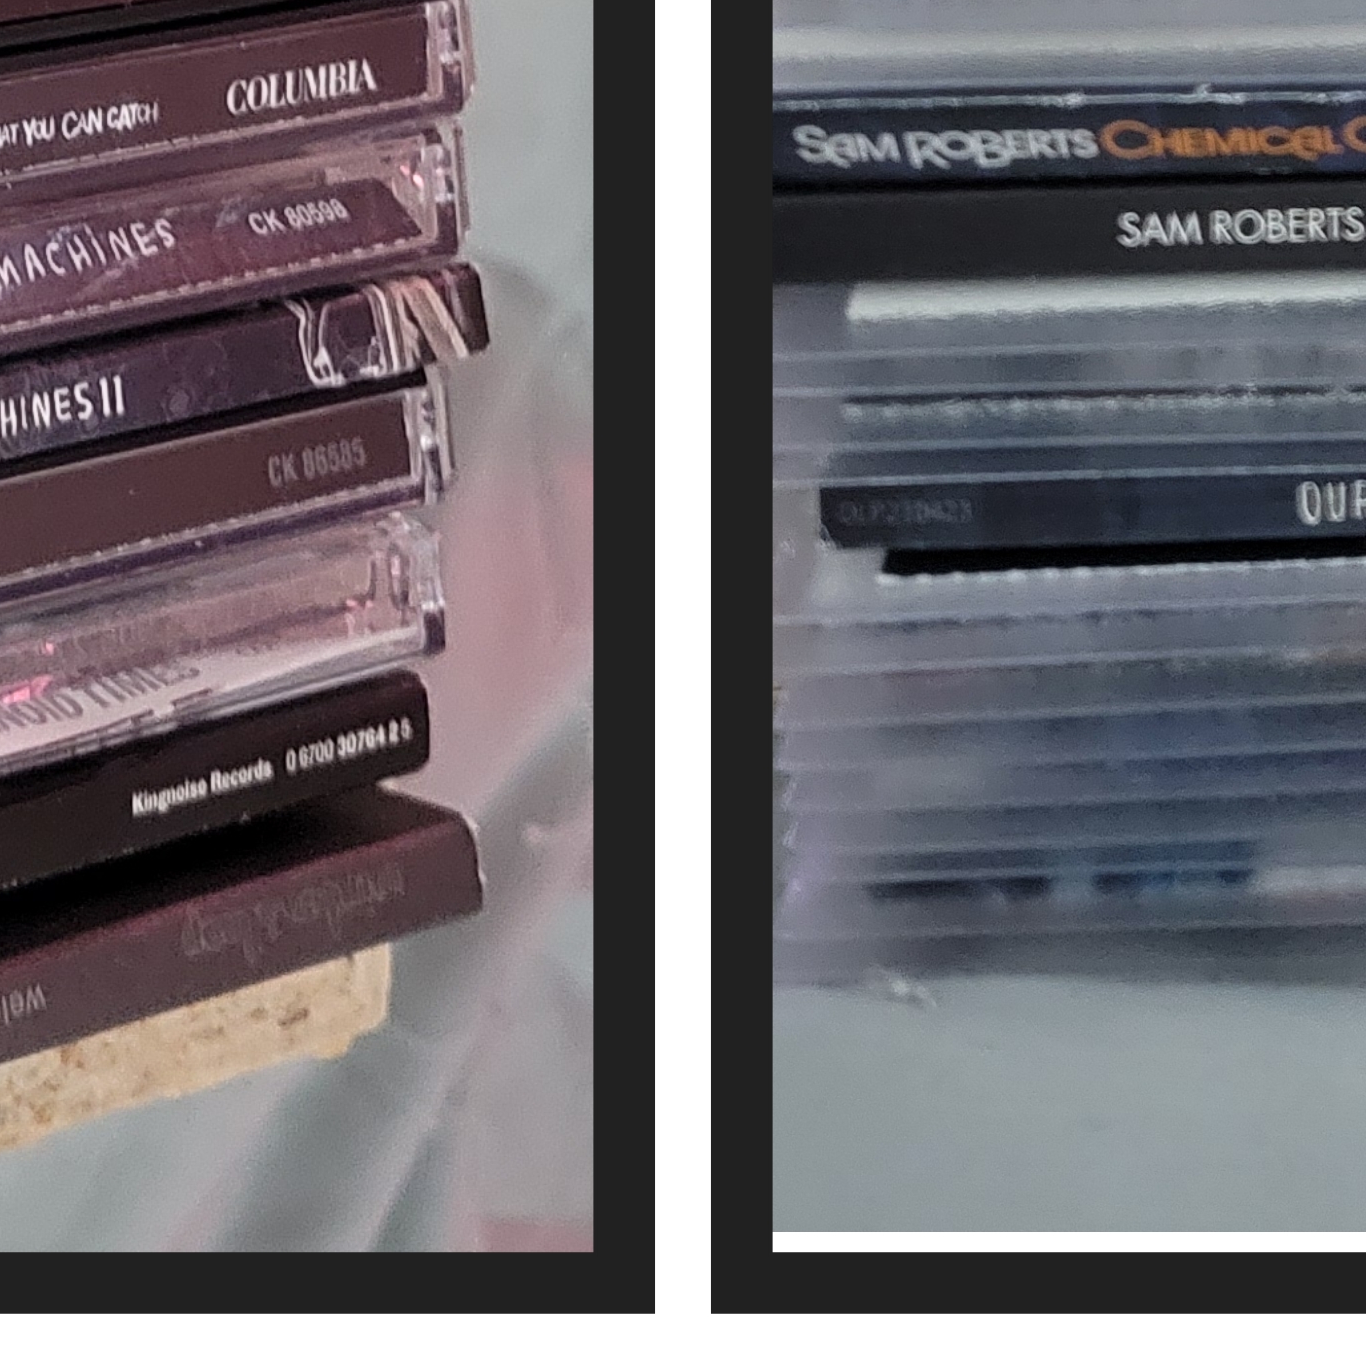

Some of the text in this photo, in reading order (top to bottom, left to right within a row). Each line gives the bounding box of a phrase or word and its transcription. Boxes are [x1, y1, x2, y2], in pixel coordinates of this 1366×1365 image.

[22, 117, 56, 146] YOU
[60, 108, 103, 139] CAN
[104, 99, 160, 134] CATCH
[224, 57, 378, 118] COLUMBIA
[791, 118, 1346, 169] SAM ROBERTS CHEMICAL
[246, 207, 284, 238] CK
[1116, 211, 1204, 249] SAM
[1211, 207, 1366, 245] ROBERTS
[132, 776, 208, 818] Kingnoise
[209, 756, 275, 793] Records
[298, 739, 335, 768] 6700
